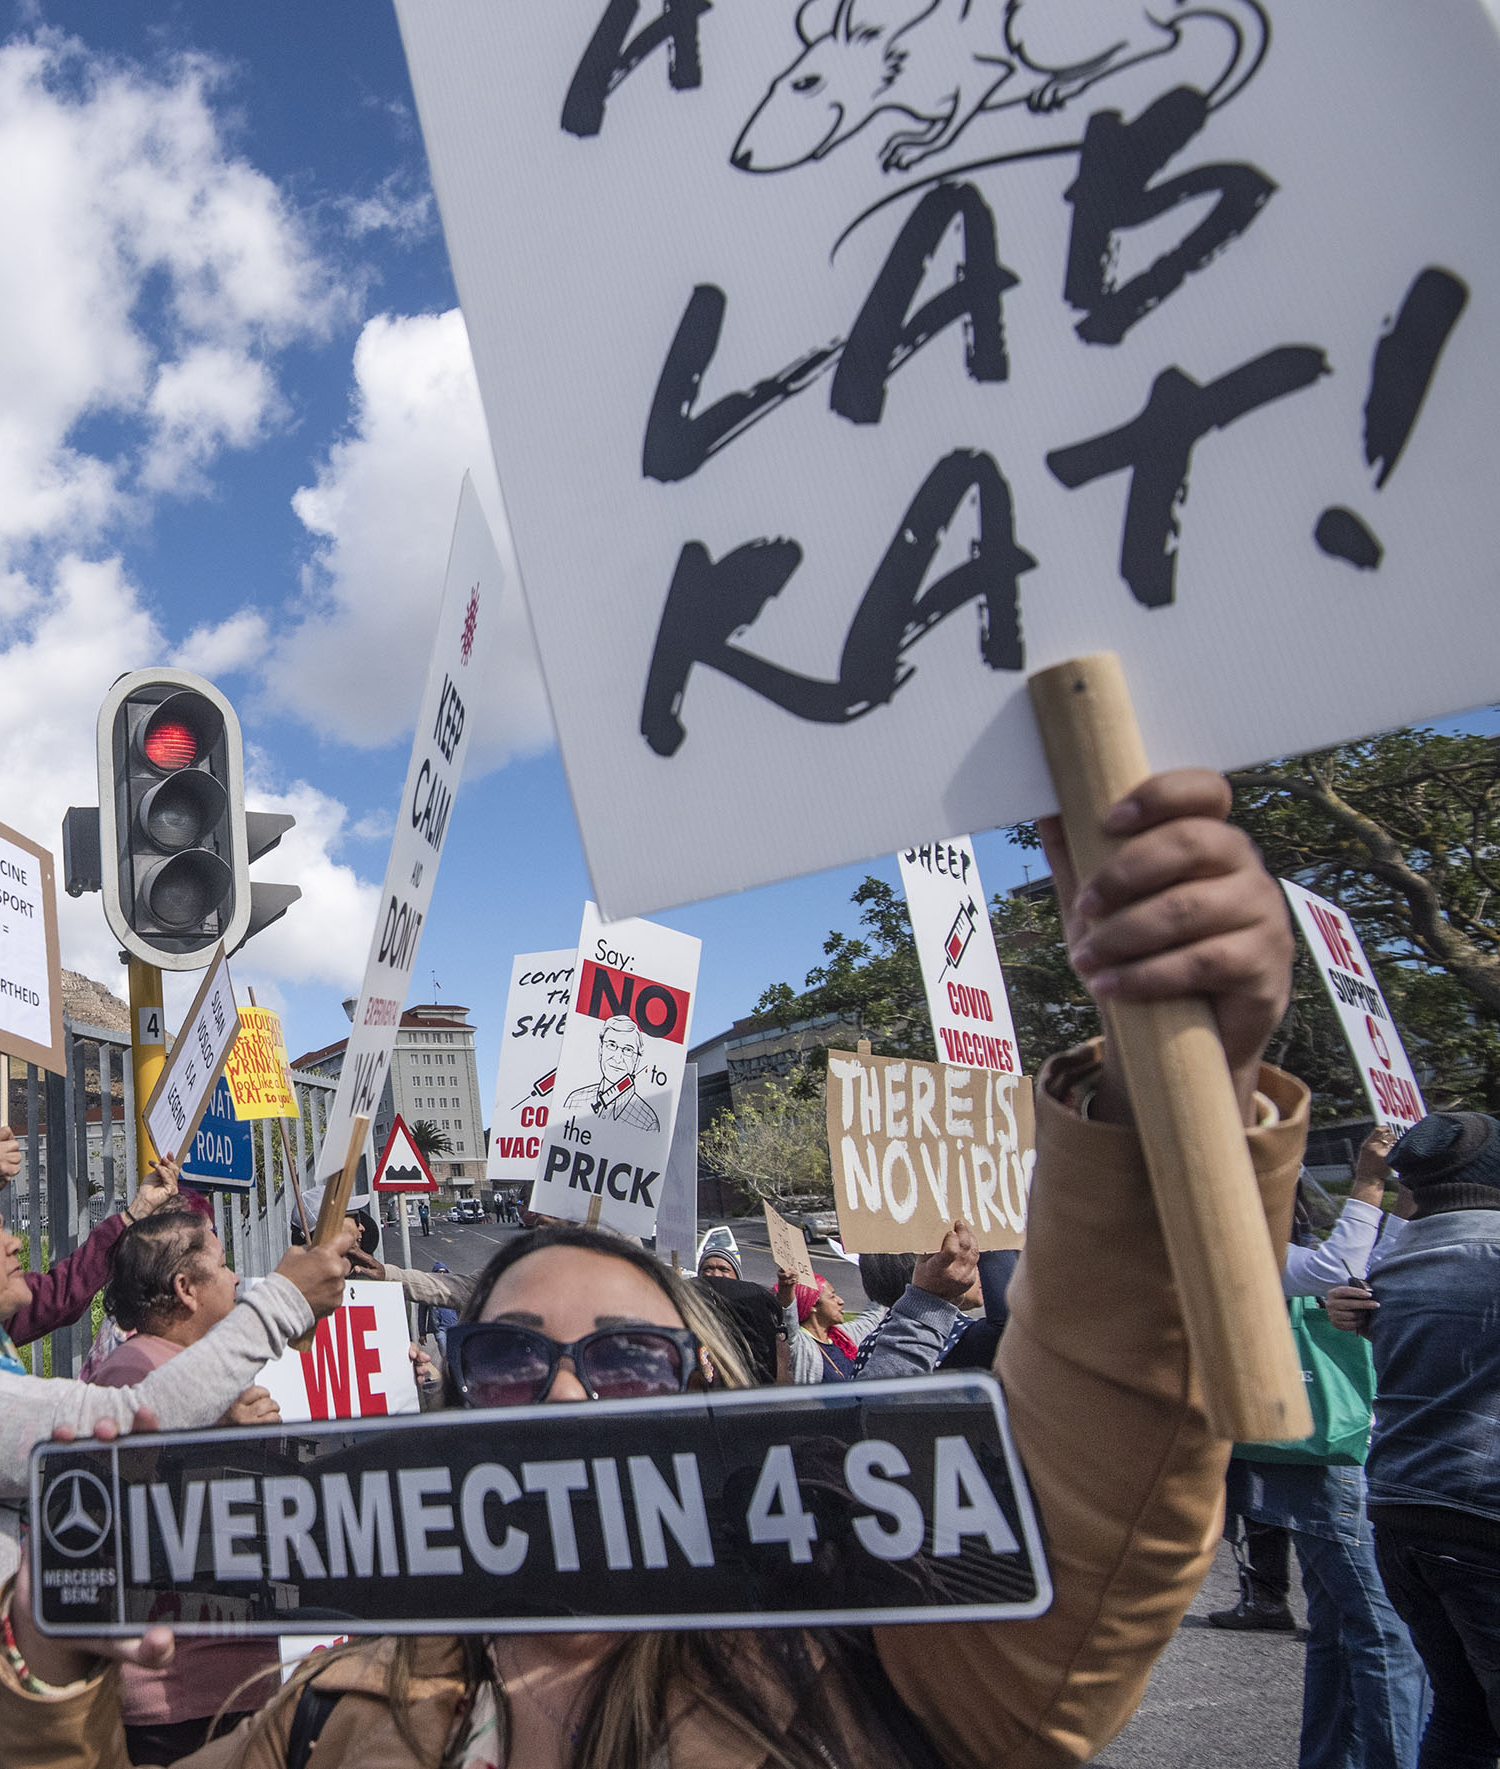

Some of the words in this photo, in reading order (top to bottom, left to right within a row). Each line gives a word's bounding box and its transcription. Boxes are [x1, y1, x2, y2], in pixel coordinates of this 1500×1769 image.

[561, 0, 703, 137] A
[642, 85, 1279, 483] LAB
[640, 266, 1469, 757] RAT!
[433, 672, 465, 766] KEEP
[412, 757, 451, 853] CALM
[378, 894, 423, 972] DON'T
[594, 938, 635, 972] Say:
[518, 967, 575, 986] CONT
[547, 989, 570, 1005] TH
[946, 980, 994, 1022] COVID
[1328, 967, 1388, 1021] SUPPORT
[146, 1012, 160, 1039] 4
[211, 990, 227, 1038] SUSAN
[511, 1011, 567, 1039] SHE
[588, 966, 678, 1039] NO
[197, 1015, 214, 1070] VOSLOO
[940, 1027, 1014, 1073] 'VACCINES'
[184, 1060, 193, 1081] IS
[188, 1072, 197, 1091] A
[650, 1064, 667, 1086] to
[1369, 1066, 1423, 1123] SUSAN
[167, 1082, 186, 1132] LEGEND
[265, 1092, 277, 1103] to
[829, 1056, 975, 1140] THERE
[984, 1069, 1019, 1152] IS
[196, 1130, 233, 1166] ROAD
[563, 1115, 592, 1146] the
[543, 1144, 661, 1209] PRICK
[840, 1134, 919, 1224] NO
[300, 1305, 389, 1421] WE
[129, 1451, 714, 1584] IVERMECTIN
[745, 1443, 815, 1565] 4
[843, 1435, 1019, 1563] SA
[42, 1567, 117, 1587] MERCEDES
[60, 1586, 100, 1604] BENZ
